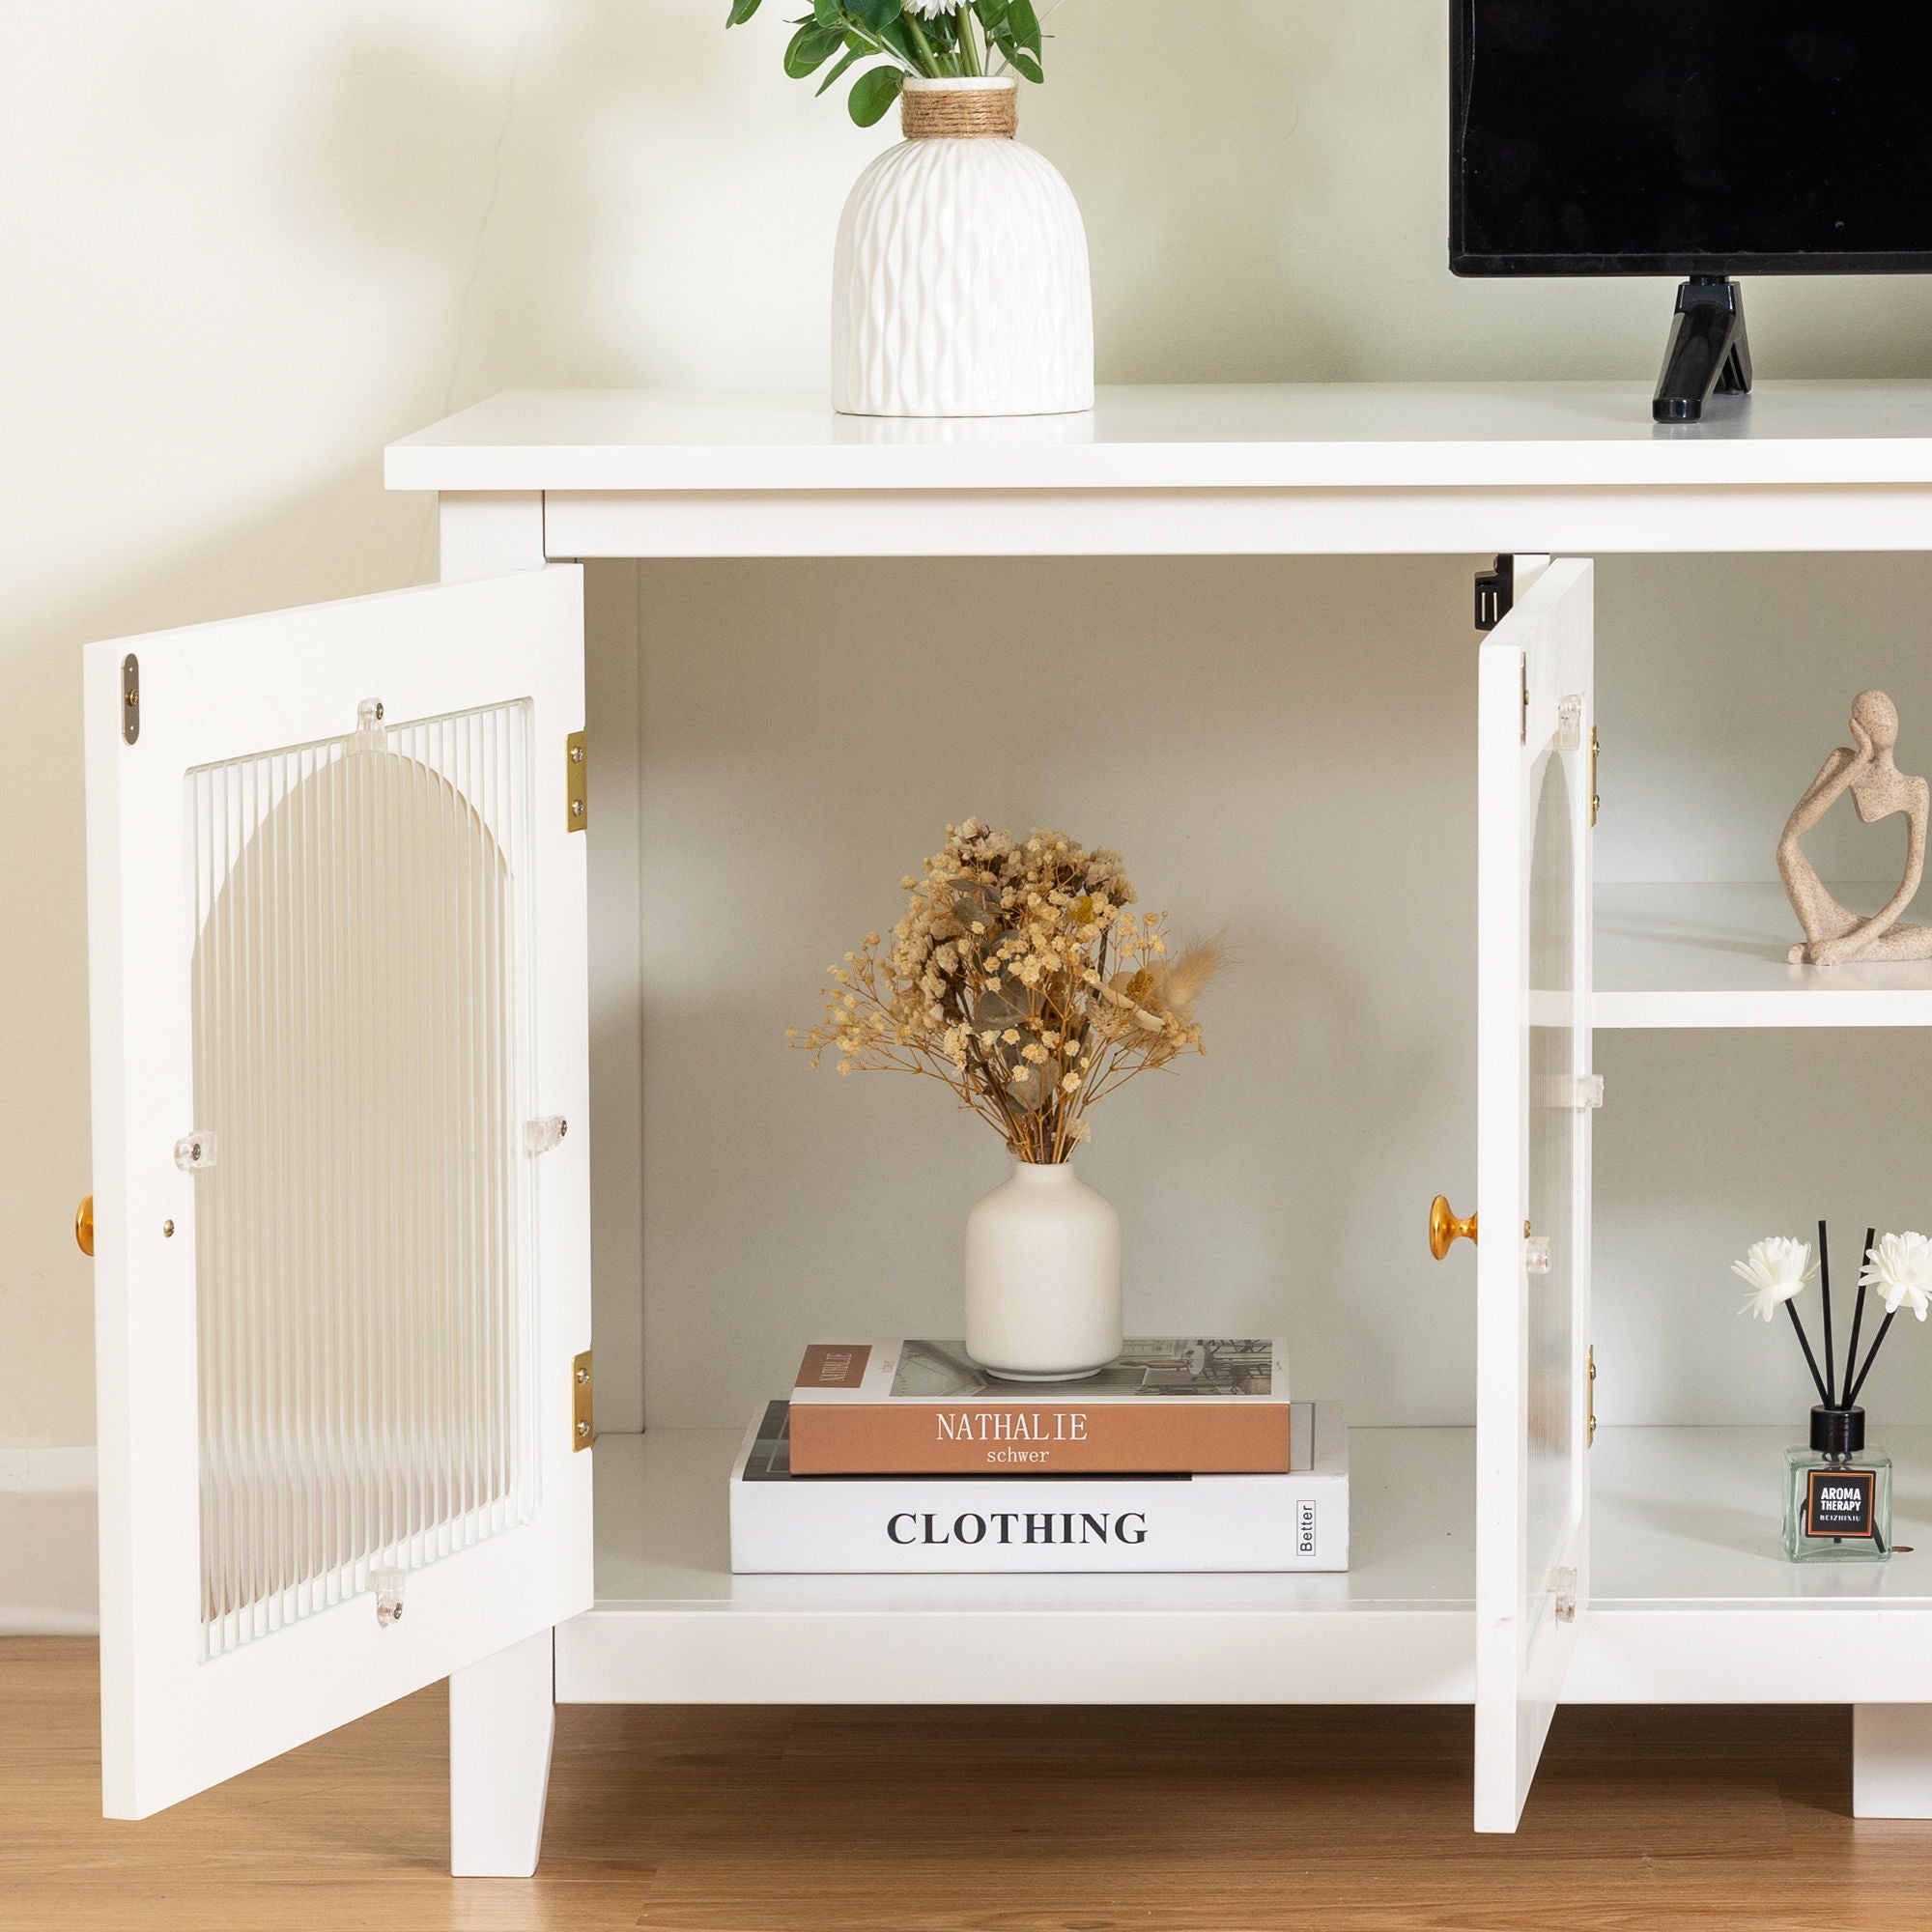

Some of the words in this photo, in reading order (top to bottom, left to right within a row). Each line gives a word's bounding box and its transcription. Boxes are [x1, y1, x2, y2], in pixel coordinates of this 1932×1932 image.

[936, 1413, 1088, 1440] NATHALIE
[986, 1446, 1050, 1463] schwer
[1821, 1488, 1861, 1500] AROMA
[1821, 1500, 1861, 1512] THERAPY
[887, 1513, 1149, 1545] CLOTHING
[1300, 1505, 1313, 1551] Better
